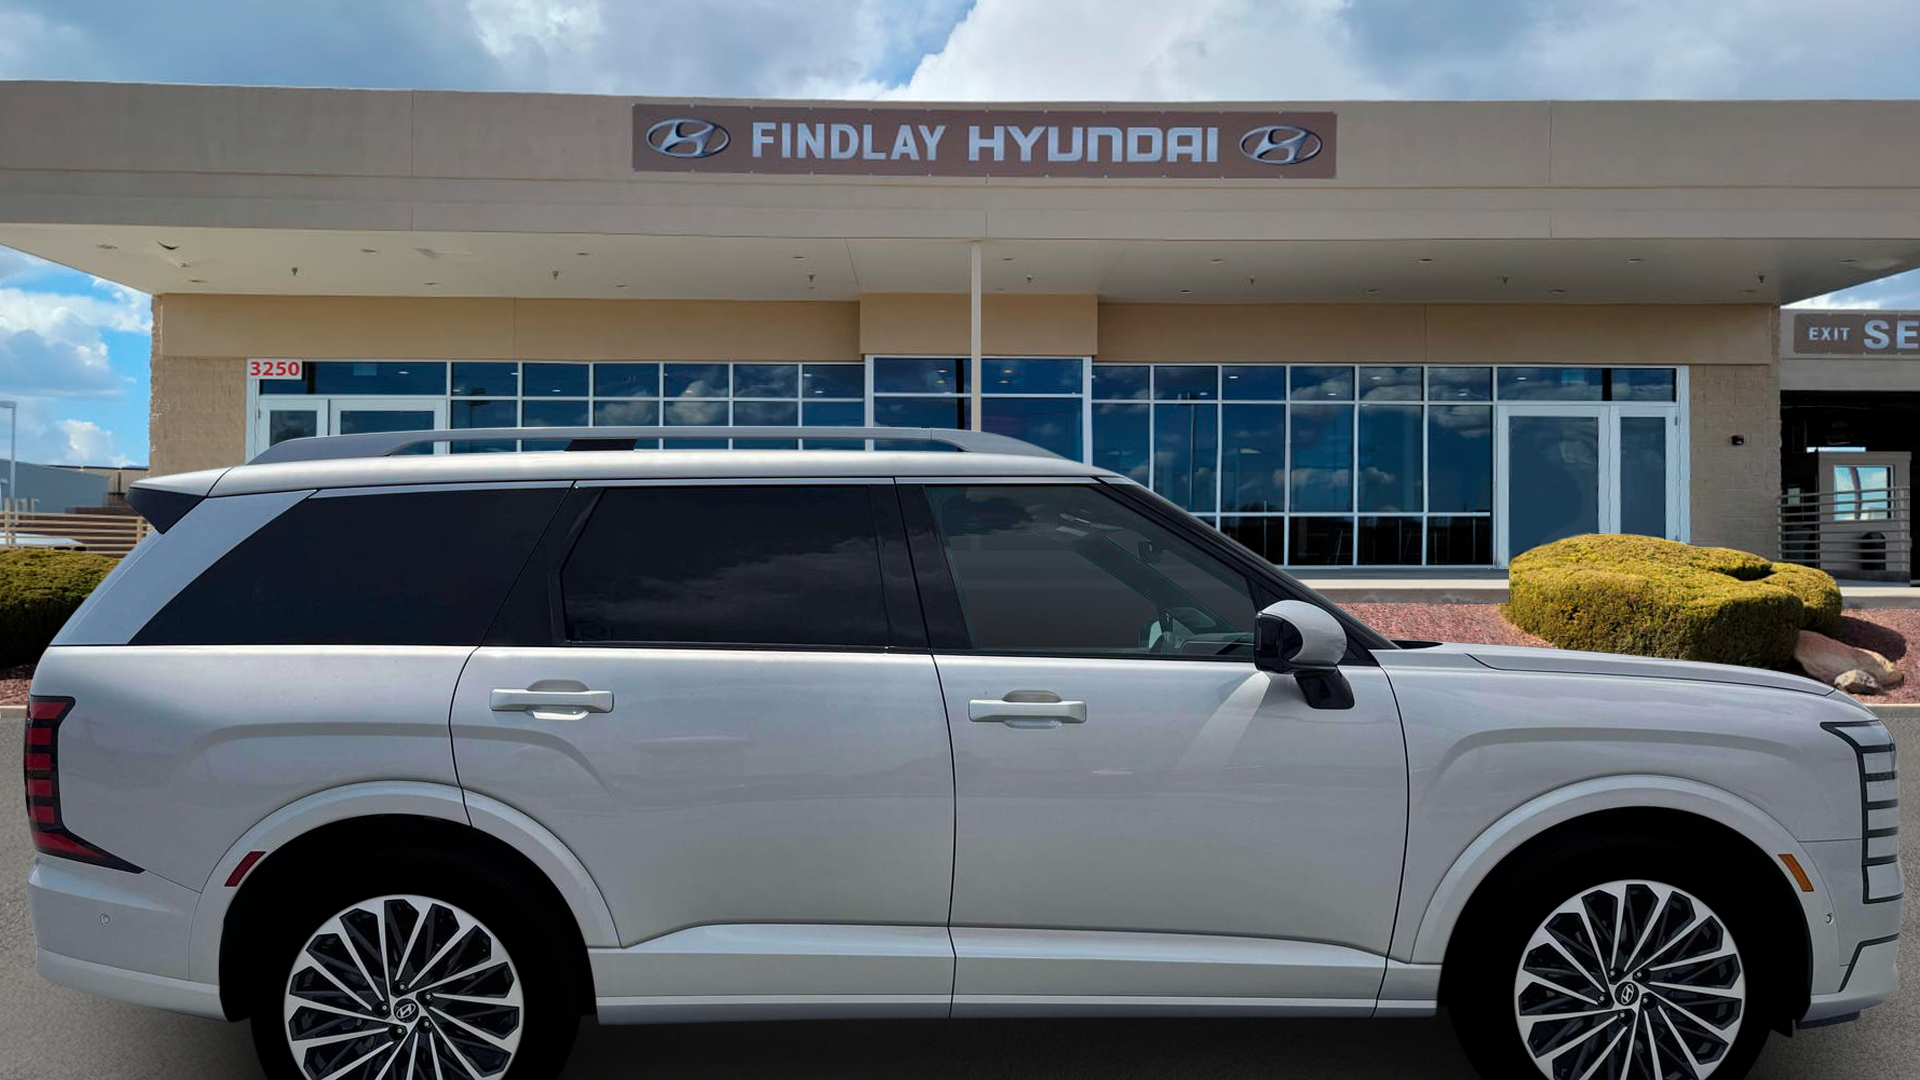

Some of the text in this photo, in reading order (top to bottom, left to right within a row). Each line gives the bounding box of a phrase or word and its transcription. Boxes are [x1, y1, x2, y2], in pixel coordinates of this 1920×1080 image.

[752, 121, 1219, 163] FINDLAY HYUNDAI
[1808, 326, 1850, 341] EXIT
[250, 361, 300, 376] 3250
